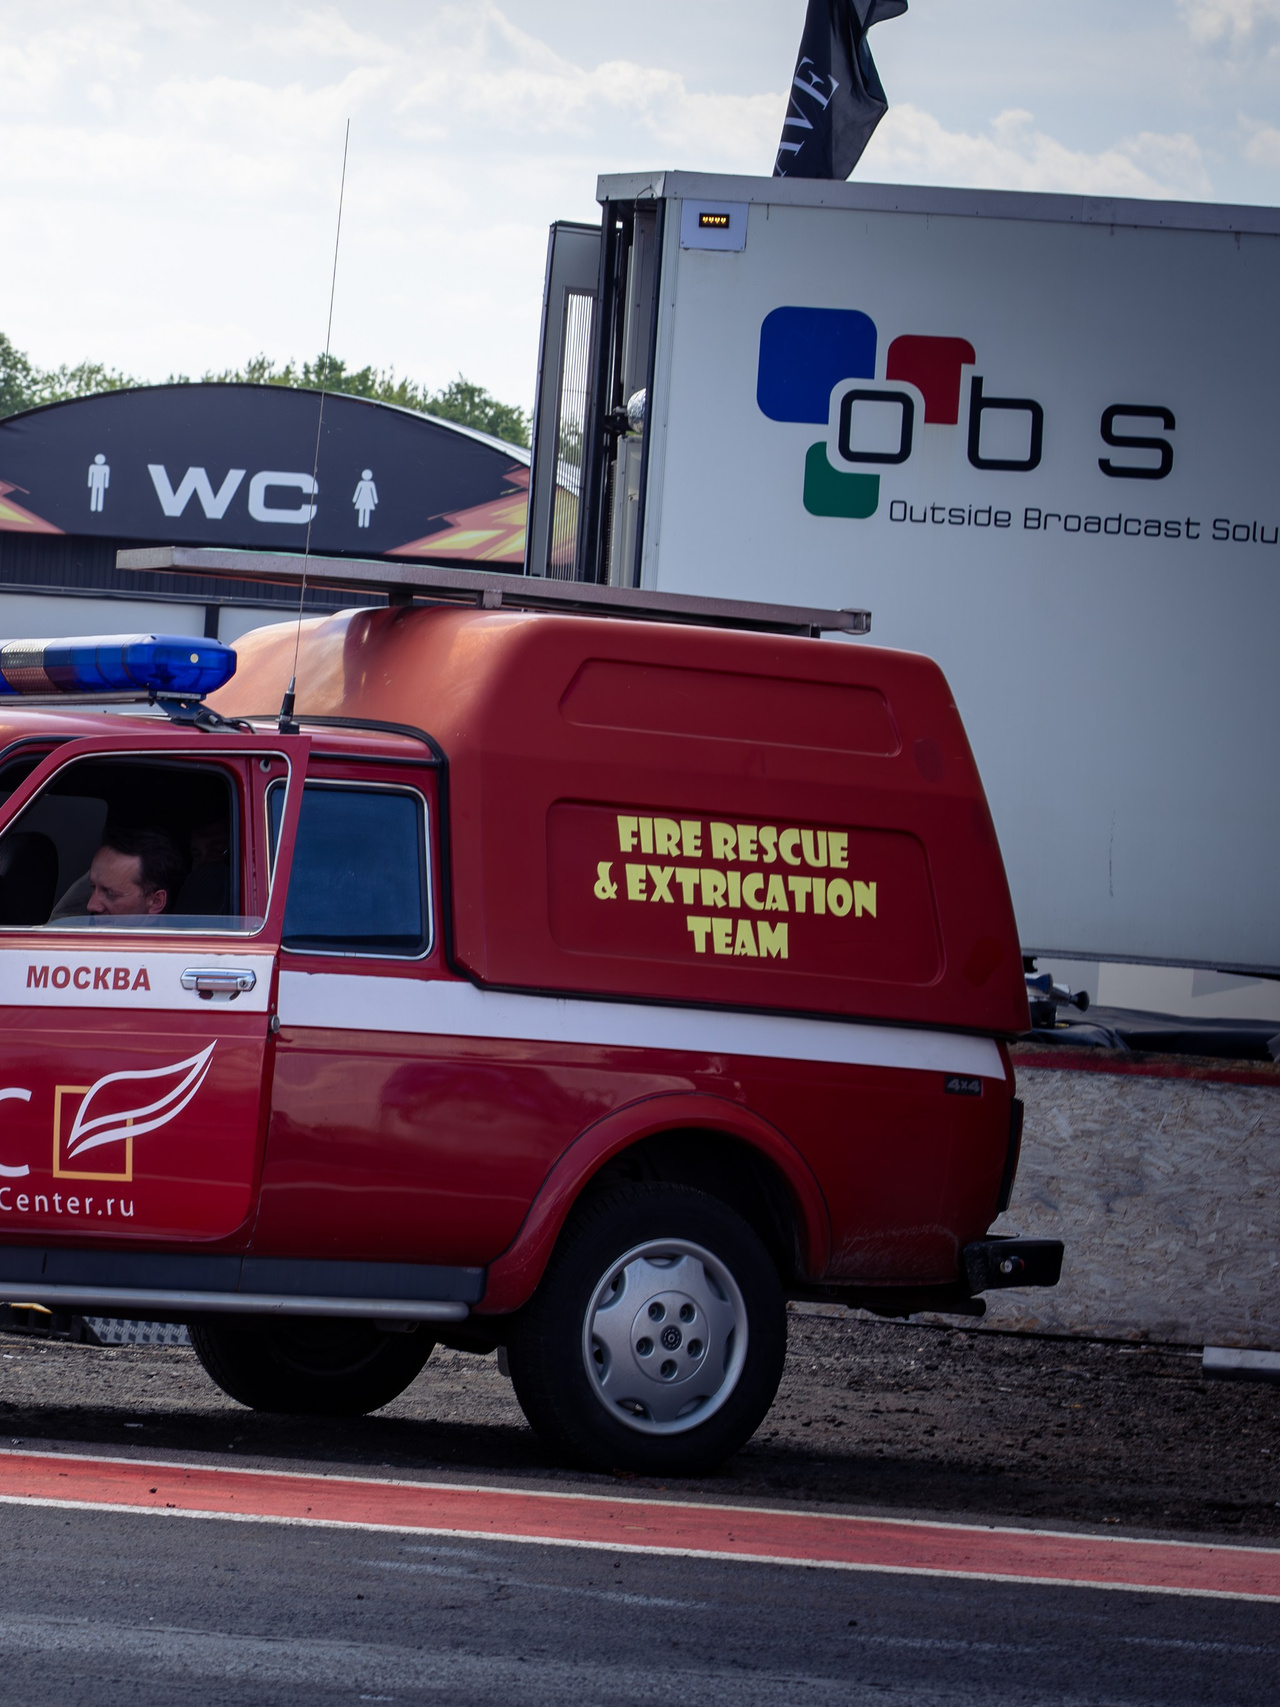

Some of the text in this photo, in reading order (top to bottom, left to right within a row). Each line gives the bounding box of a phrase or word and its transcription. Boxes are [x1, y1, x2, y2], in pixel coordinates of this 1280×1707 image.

[147, 463, 319, 524] WC
[889, 499, 1279, 545] Outside Broadcast Solu
[617, 815, 850, 869] FIRE RESCUE
[593, 861, 878, 919] & EXTRICATION
[686, 915, 789, 960] TEAM
[26, 964, 152, 992] МОСКВА
